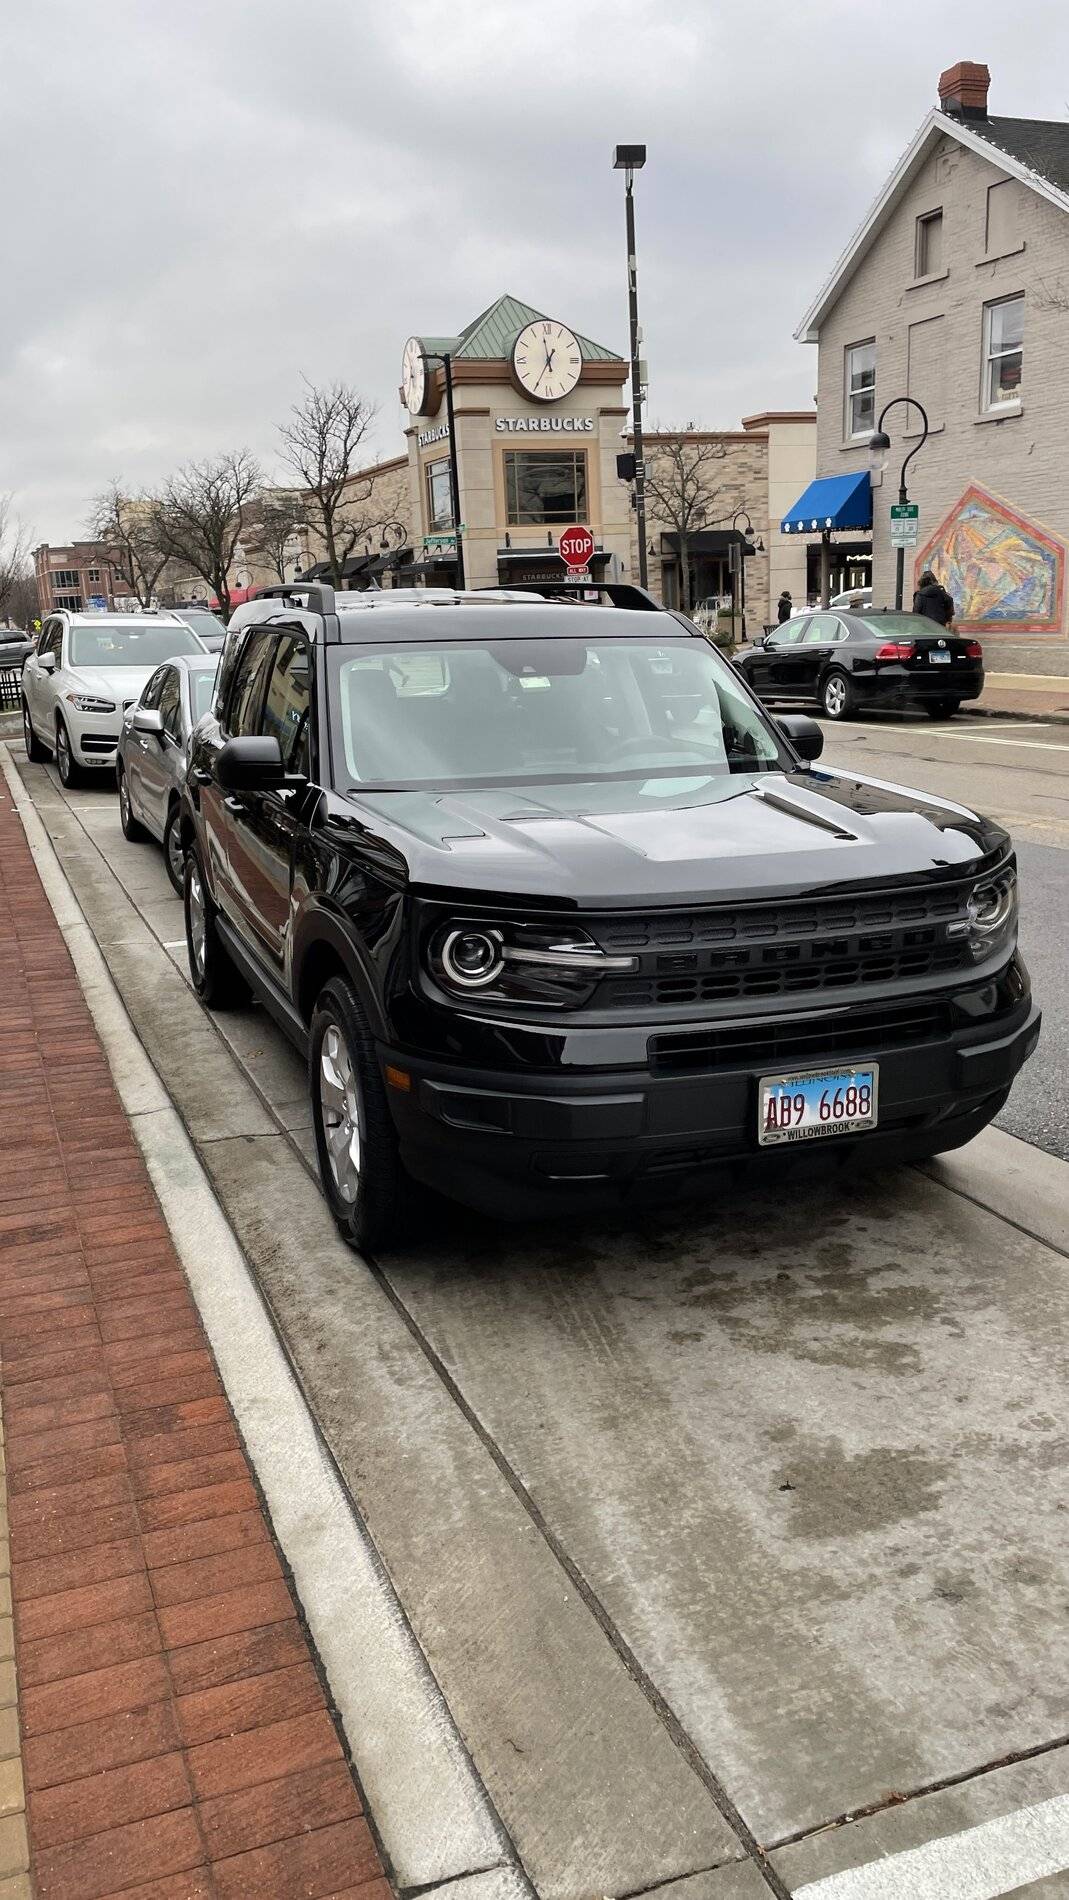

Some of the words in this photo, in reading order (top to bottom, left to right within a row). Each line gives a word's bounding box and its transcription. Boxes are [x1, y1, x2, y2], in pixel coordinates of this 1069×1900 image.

[495, 417, 594, 432] STARBUCKS
[562, 539, 591, 554] STOP
[656, 928, 936, 971] BRONCO
[766, 1093, 805, 1129] AB9
[819, 1084, 871, 1121] 6688
[787, 1122, 850, 1140] WILLOWBROOK
